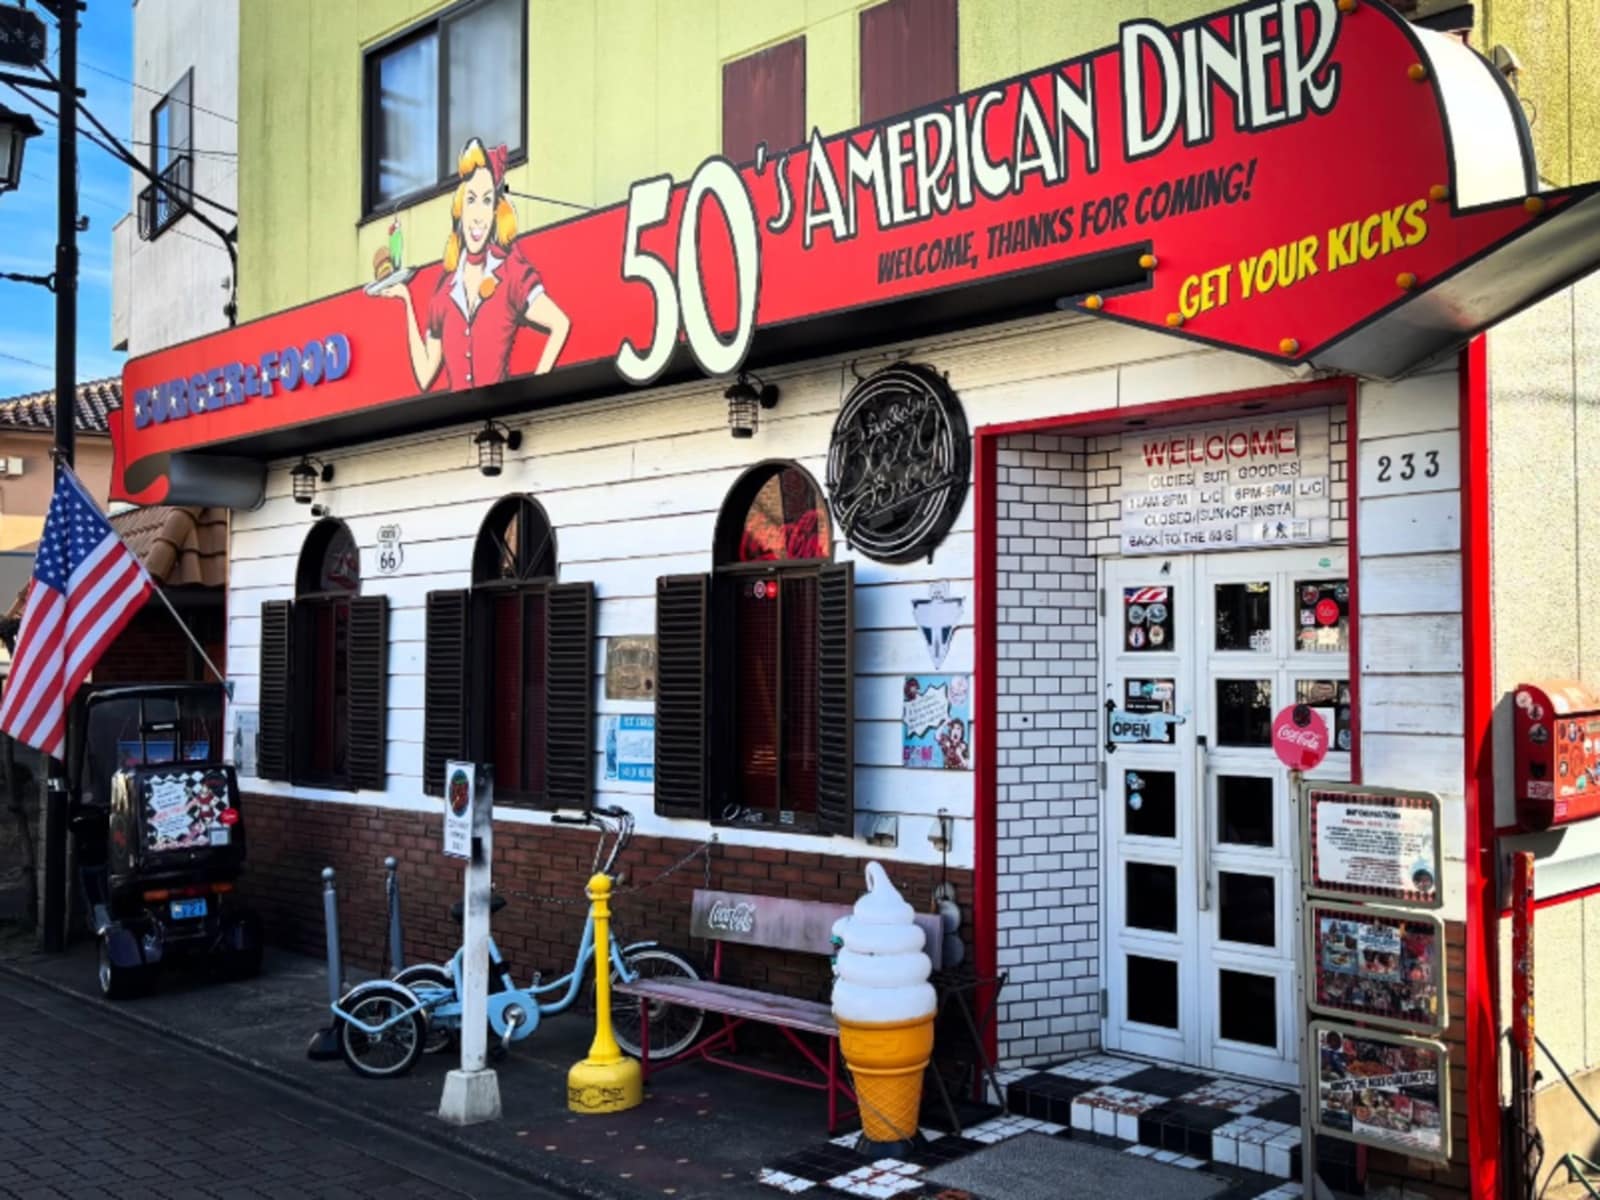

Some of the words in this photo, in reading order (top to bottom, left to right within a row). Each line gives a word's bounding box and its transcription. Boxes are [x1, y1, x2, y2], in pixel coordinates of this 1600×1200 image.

[803, 61, 1099, 249] AMERICAN
[1120, 0, 1340, 161] DINER
[877, 230, 978, 284] WELCOME,
[987, 206, 1073, 260] THANKS
[1080, 192, 1129, 239] FOR
[1134, 158, 1258, 225] COMING!
[1178, 264, 1232, 319] GET
[1231, 235, 1319, 299] YOUR
[1327, 199, 1429, 272] KICKS
[1143, 427, 1297, 467] WELCOME
[1150, 472, 1195, 489] OLDIES
[1203, 470, 1228, 484] BUT
[1237, 462, 1300, 480] GOODIES
[1377, 449, 1440, 482] 233
[1128, 535, 1159, 548] BACK
[1164, 533, 1180, 545] TO
[1183, 531, 1206, 544] THE
[380, 551, 396, 569] 66
[1111, 720, 1150, 738] OPEN
